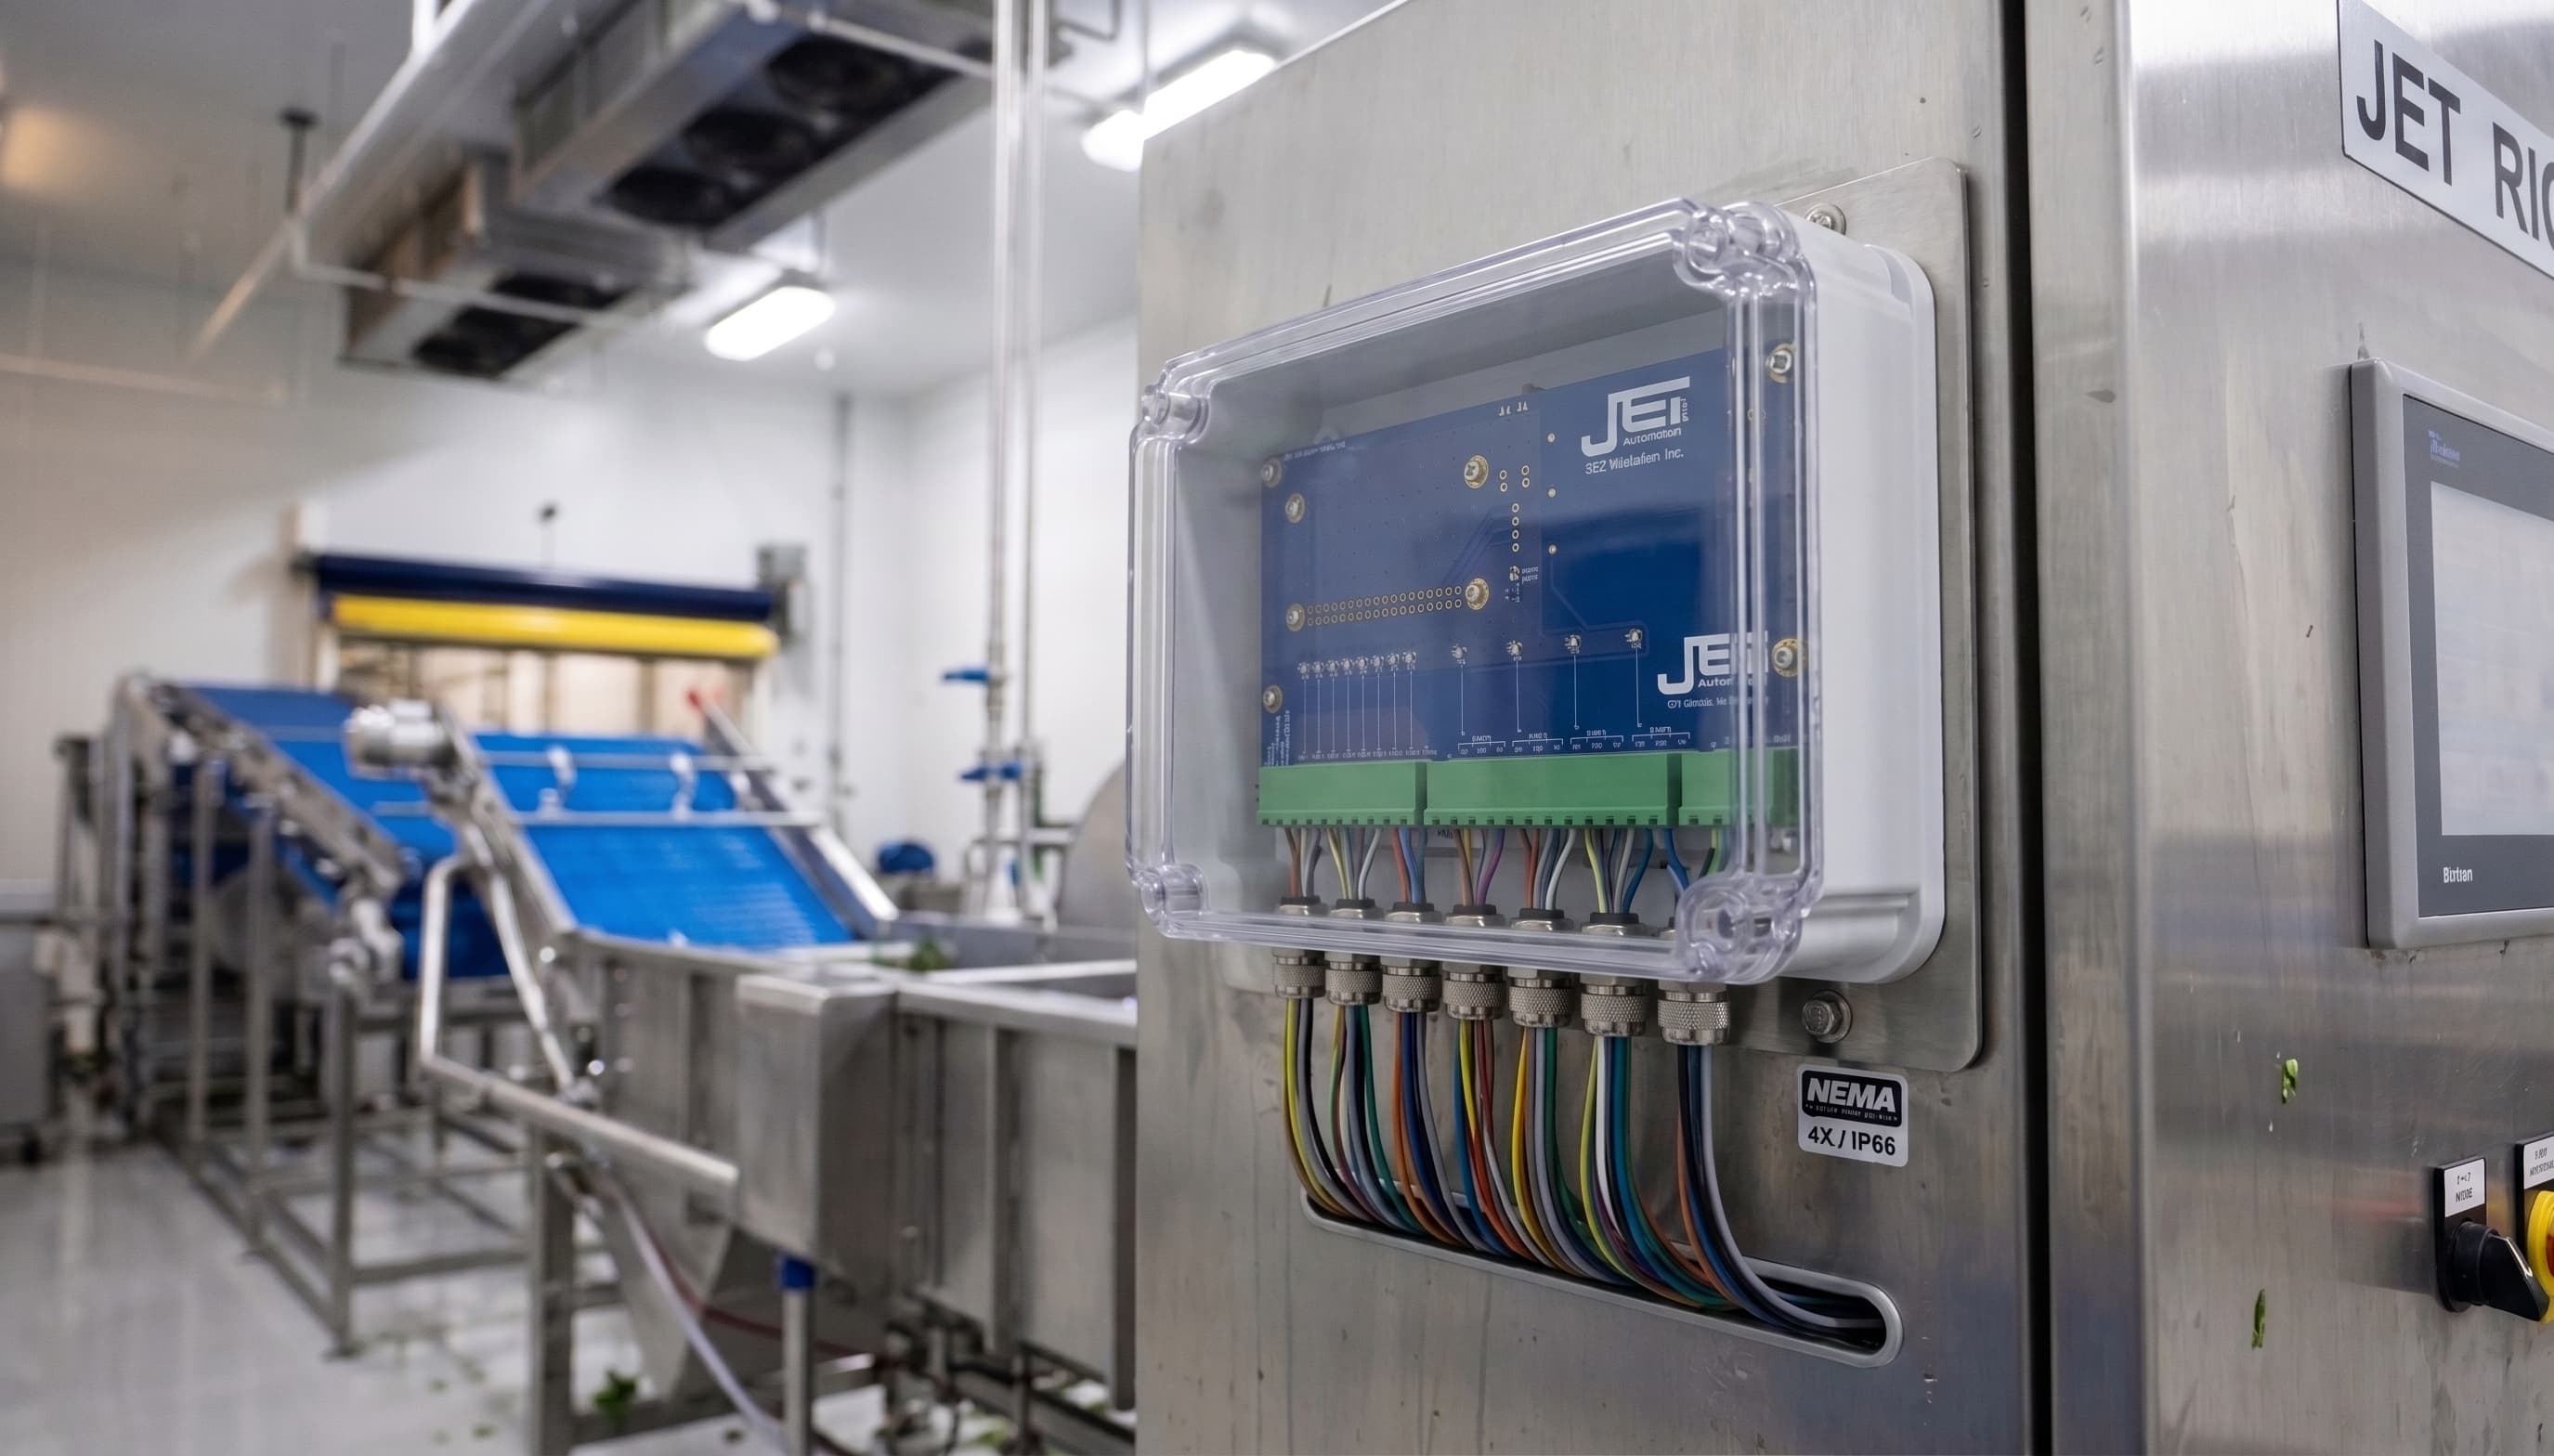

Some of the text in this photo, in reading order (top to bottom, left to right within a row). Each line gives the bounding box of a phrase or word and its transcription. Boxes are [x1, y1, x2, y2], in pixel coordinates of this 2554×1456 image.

[2356, 39, 2461, 187] JET
[1664, 448, 1684, 461] Inc.
[1806, 1077, 1896, 1112] NEMA
[1807, 1125, 1835, 1147] 4X
[1852, 1130, 1896, 1156] IP66
